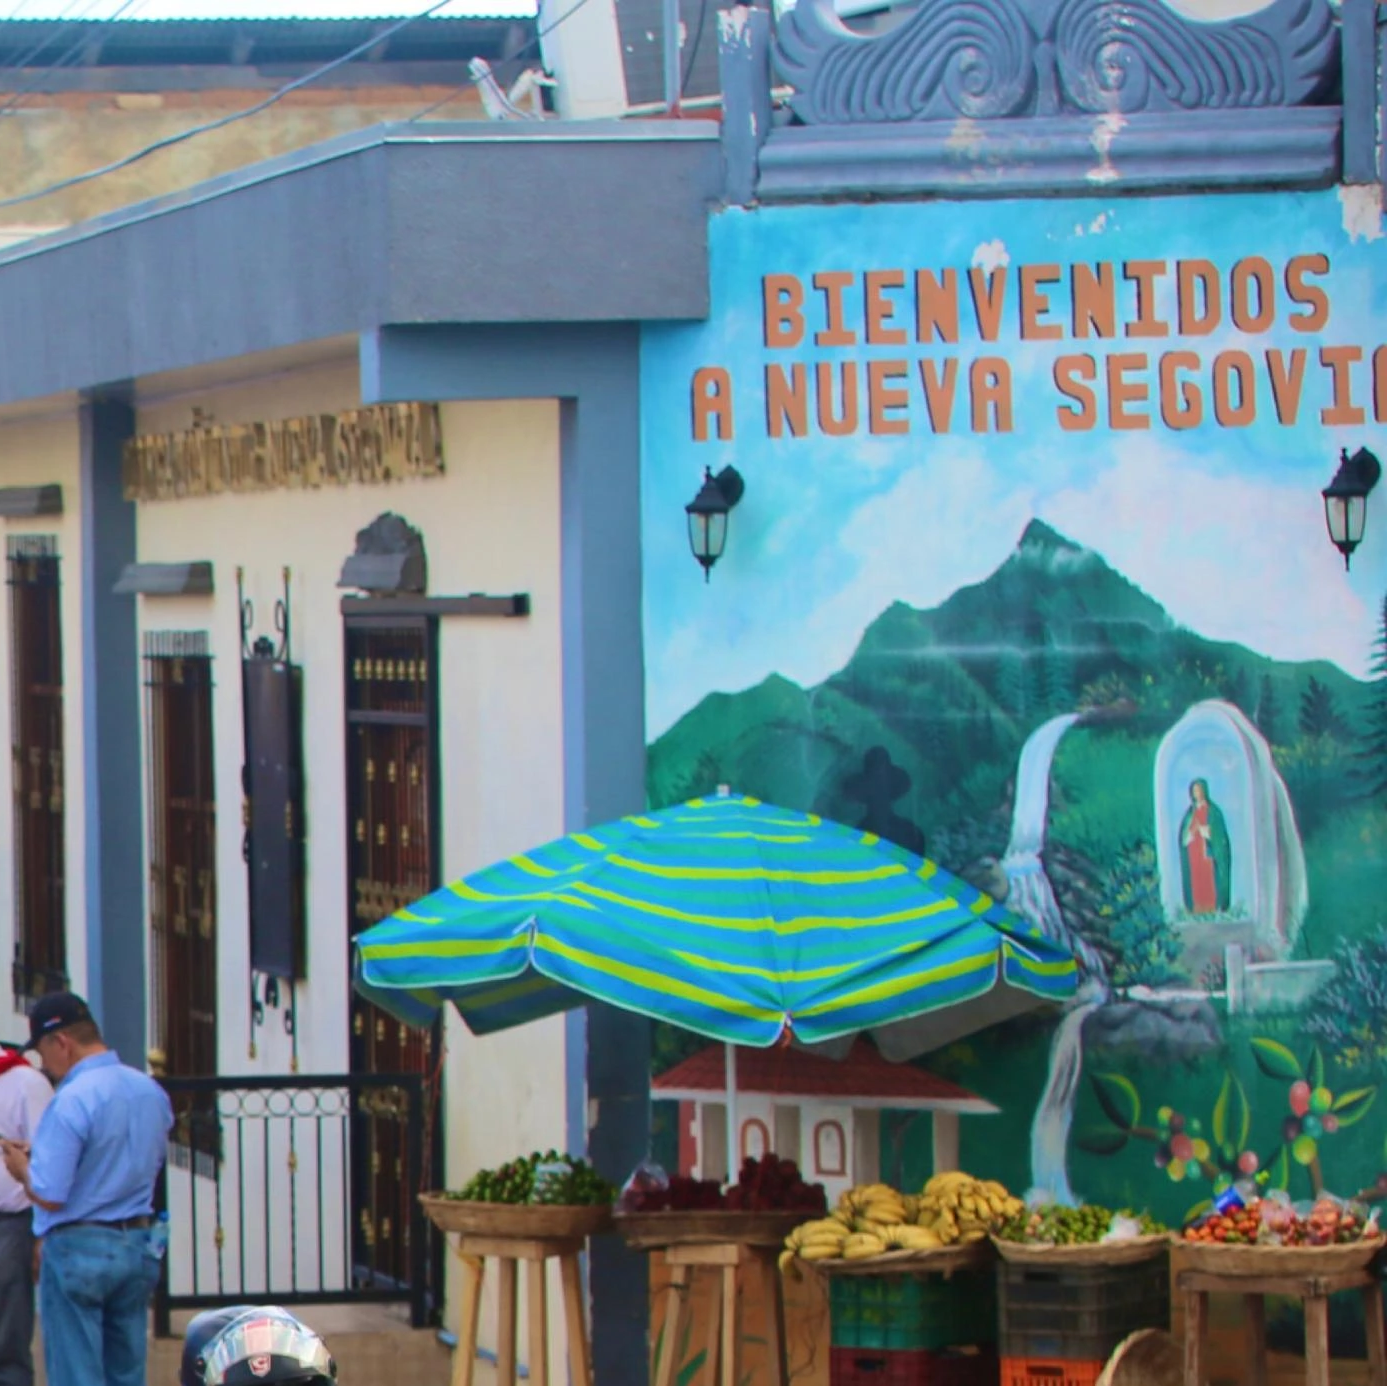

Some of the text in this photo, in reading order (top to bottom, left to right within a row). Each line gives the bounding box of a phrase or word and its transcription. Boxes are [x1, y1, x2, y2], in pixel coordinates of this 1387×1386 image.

[762, 253, 1330, 348] BIENVENIDOS
[690, 366, 733, 441] A
[765, 356, 1013, 438] NUEVA
